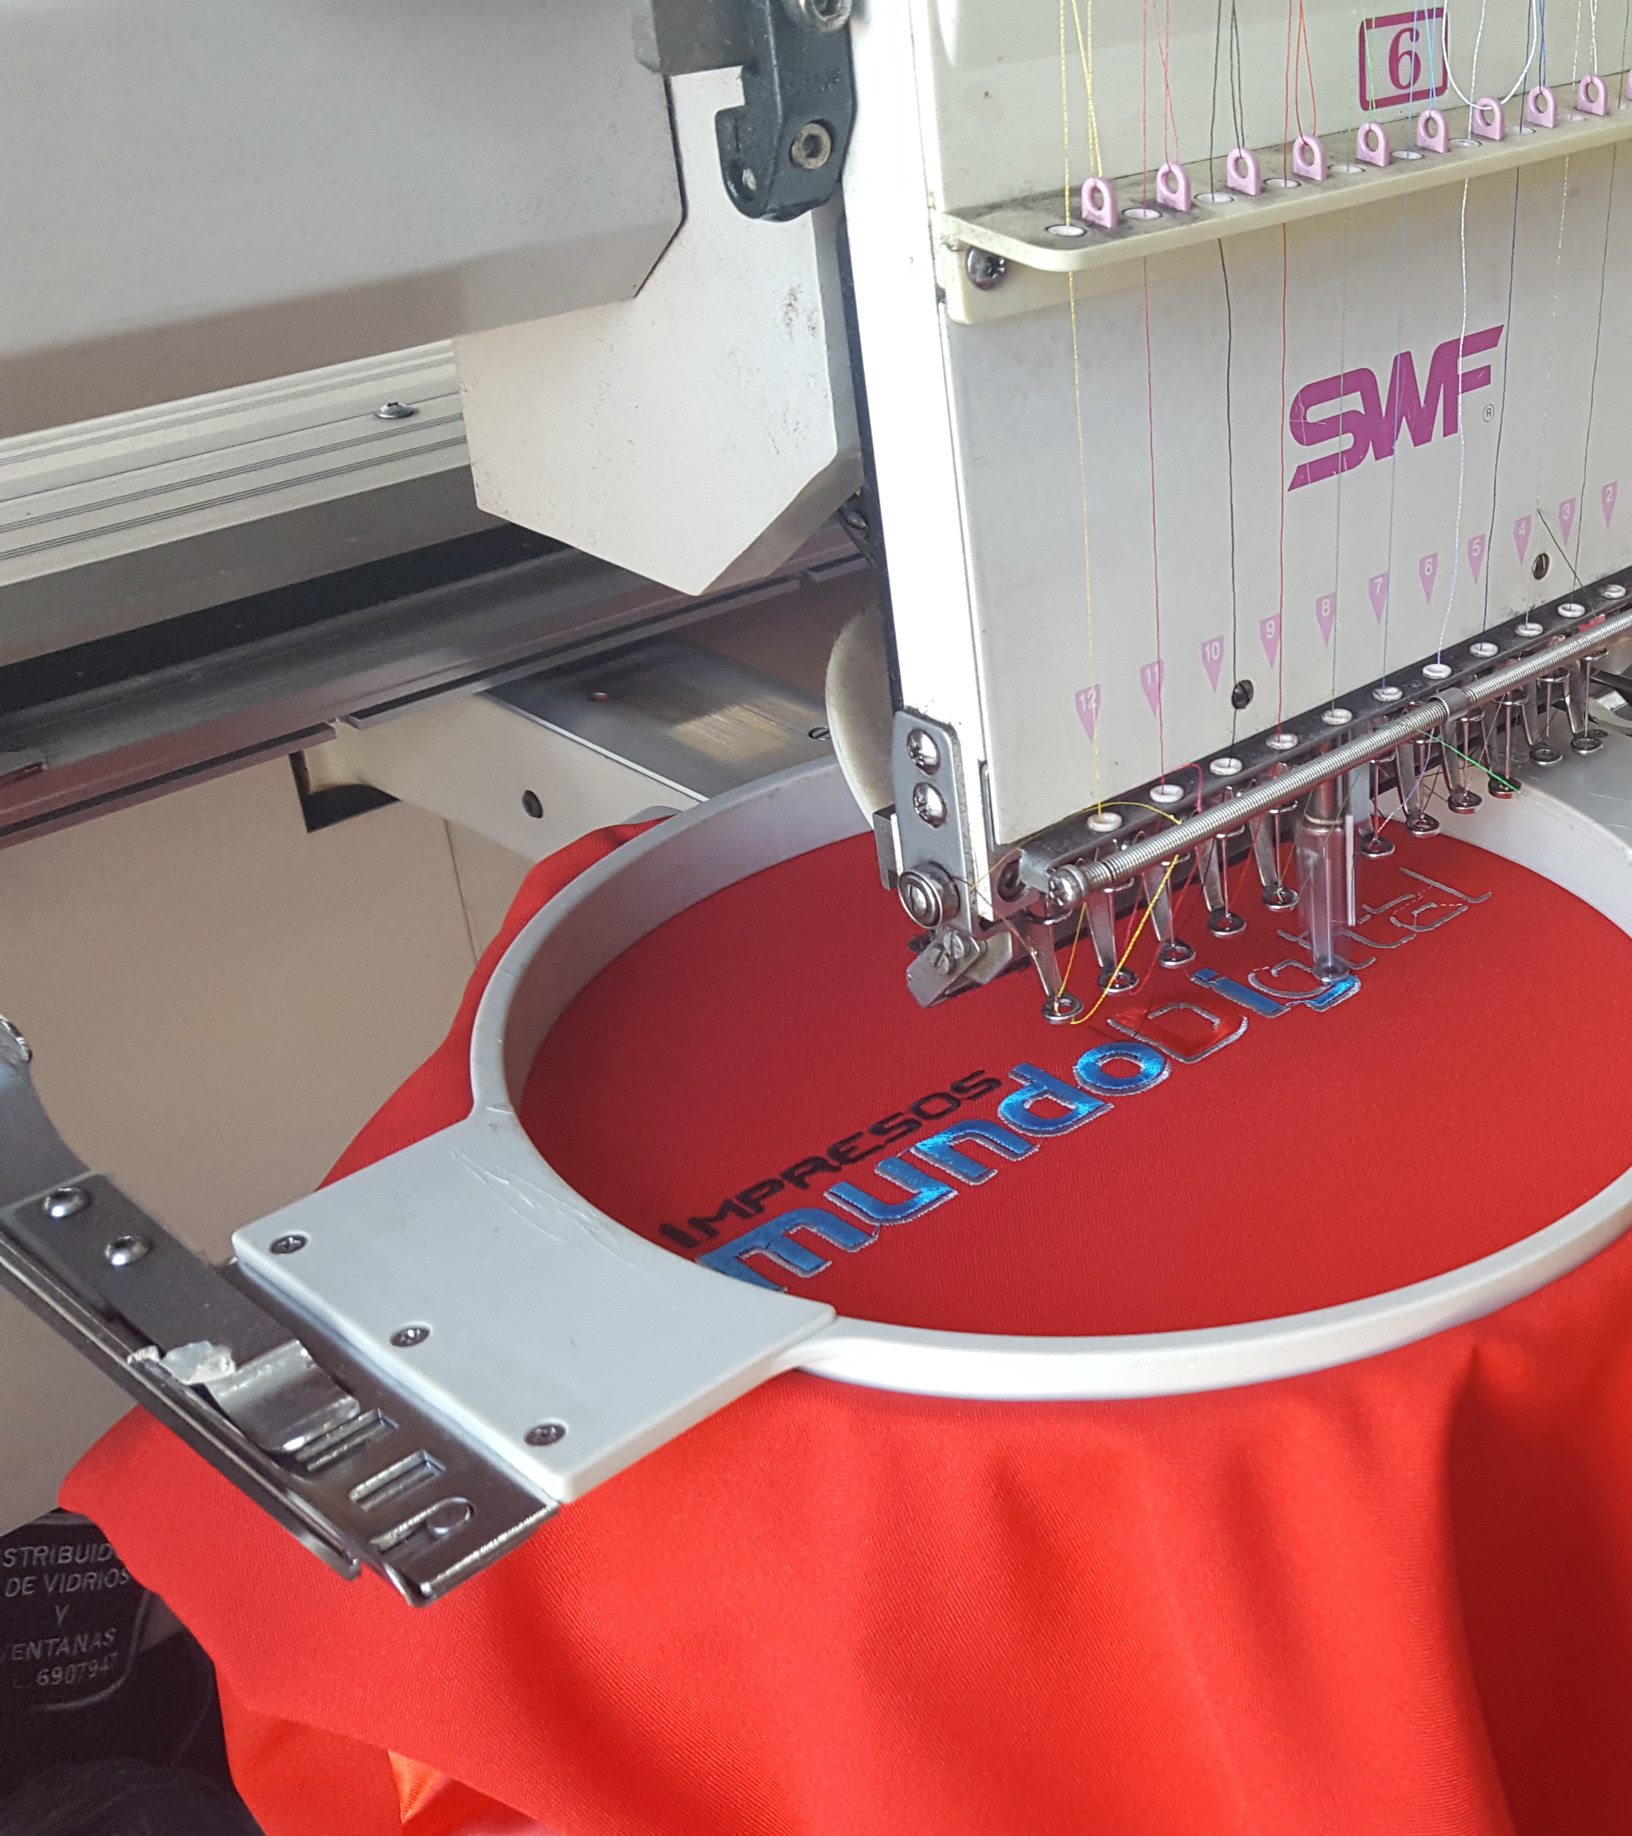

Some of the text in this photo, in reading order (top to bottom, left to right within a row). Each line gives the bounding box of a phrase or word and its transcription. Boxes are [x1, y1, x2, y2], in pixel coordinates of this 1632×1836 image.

[1388, 27, 1422, 90] 6
[1287, 324, 1504, 492] SWF
[1204, 641, 1220, 662] 10
[1266, 620, 1275, 639] 9
[1321, 598, 1331, 616] 8
[1374, 577, 1383, 594] 7
[1424, 559, 1433, 576] 6
[1472, 539, 1481, 556] 5
[1518, 520, 1526, 536] 4
[1563, 503, 1571, 520] 3
[1606, 486, 1614, 501] 2
[659, 1070, 1002, 1248] IMPRESOS
[2, 1543, 116, 1568] STRIBUID
[5, 1567, 130, 1598] DE VIDRIOS
[55, 1604, 69, 1626] Y
